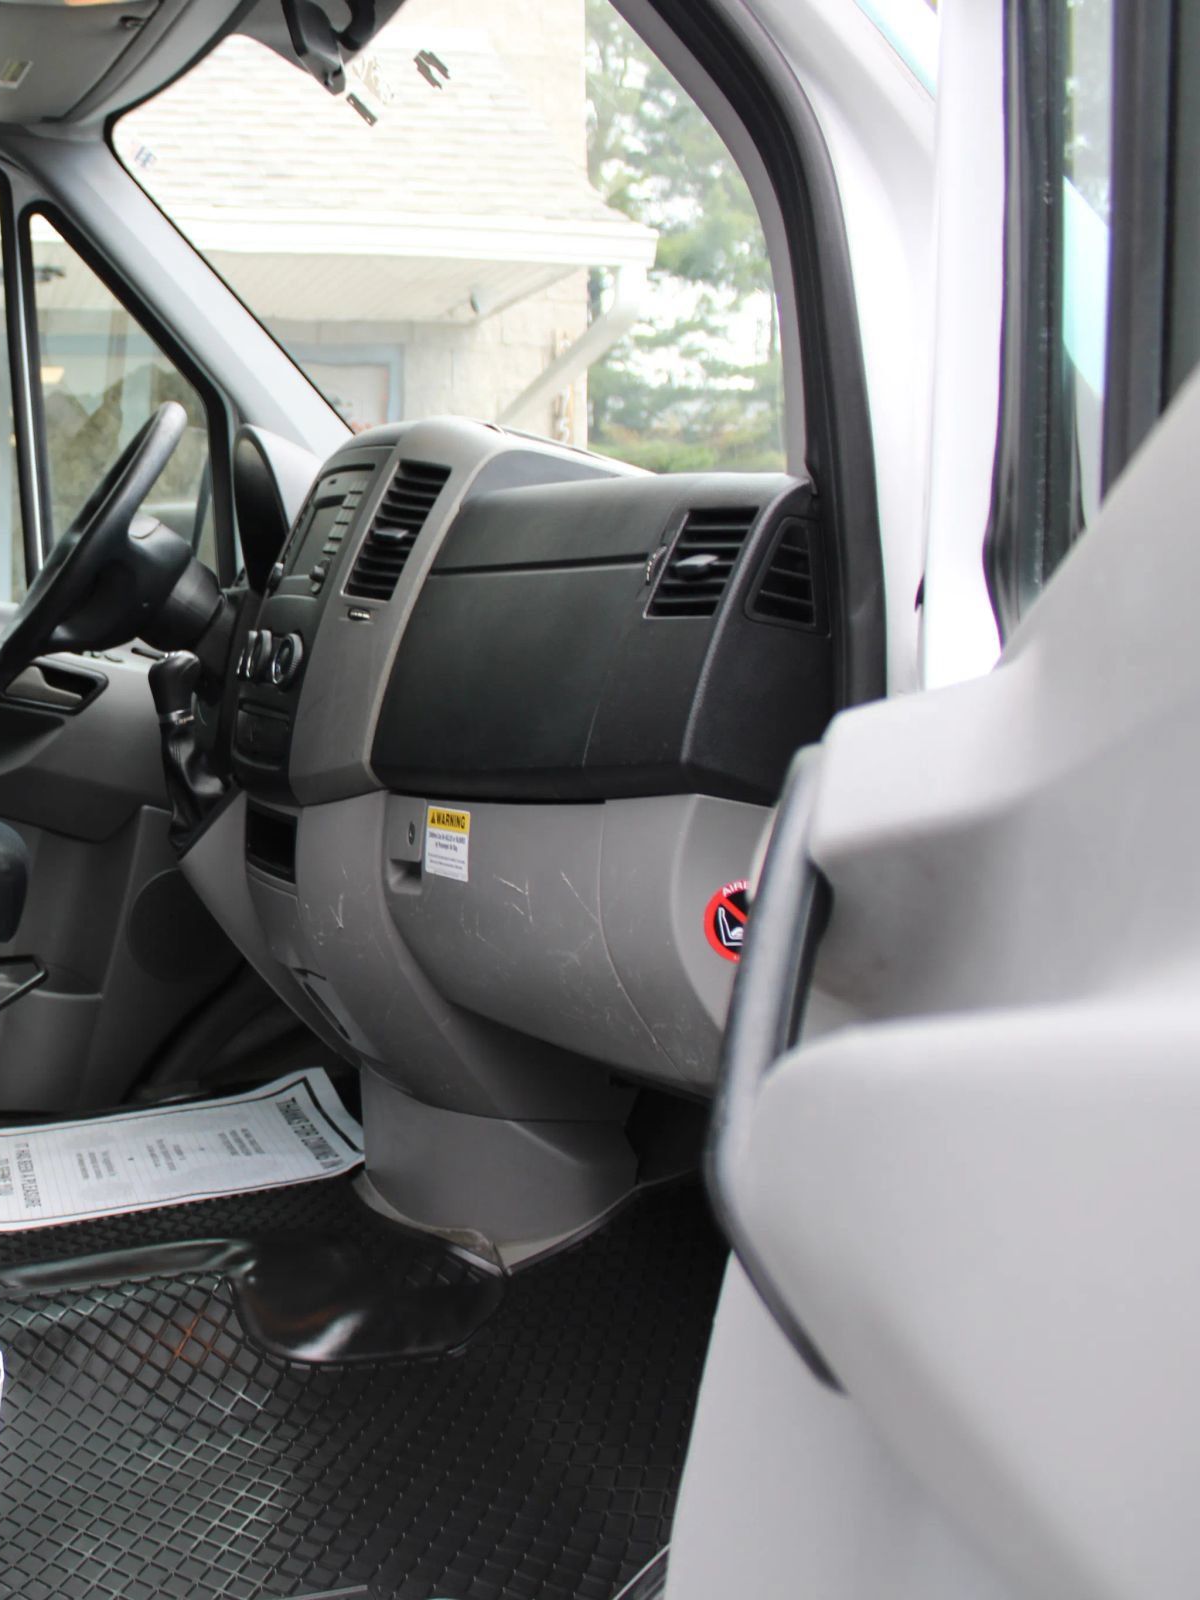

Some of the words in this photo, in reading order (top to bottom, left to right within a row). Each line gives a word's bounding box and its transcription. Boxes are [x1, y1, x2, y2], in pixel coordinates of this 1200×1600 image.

[436, 811, 466, 829] WARNING
[275, 1097, 309, 1126] THANKS
[291, 1123, 319, 1138] FOR
[22, 1178, 42, 1208] PLEASURE
